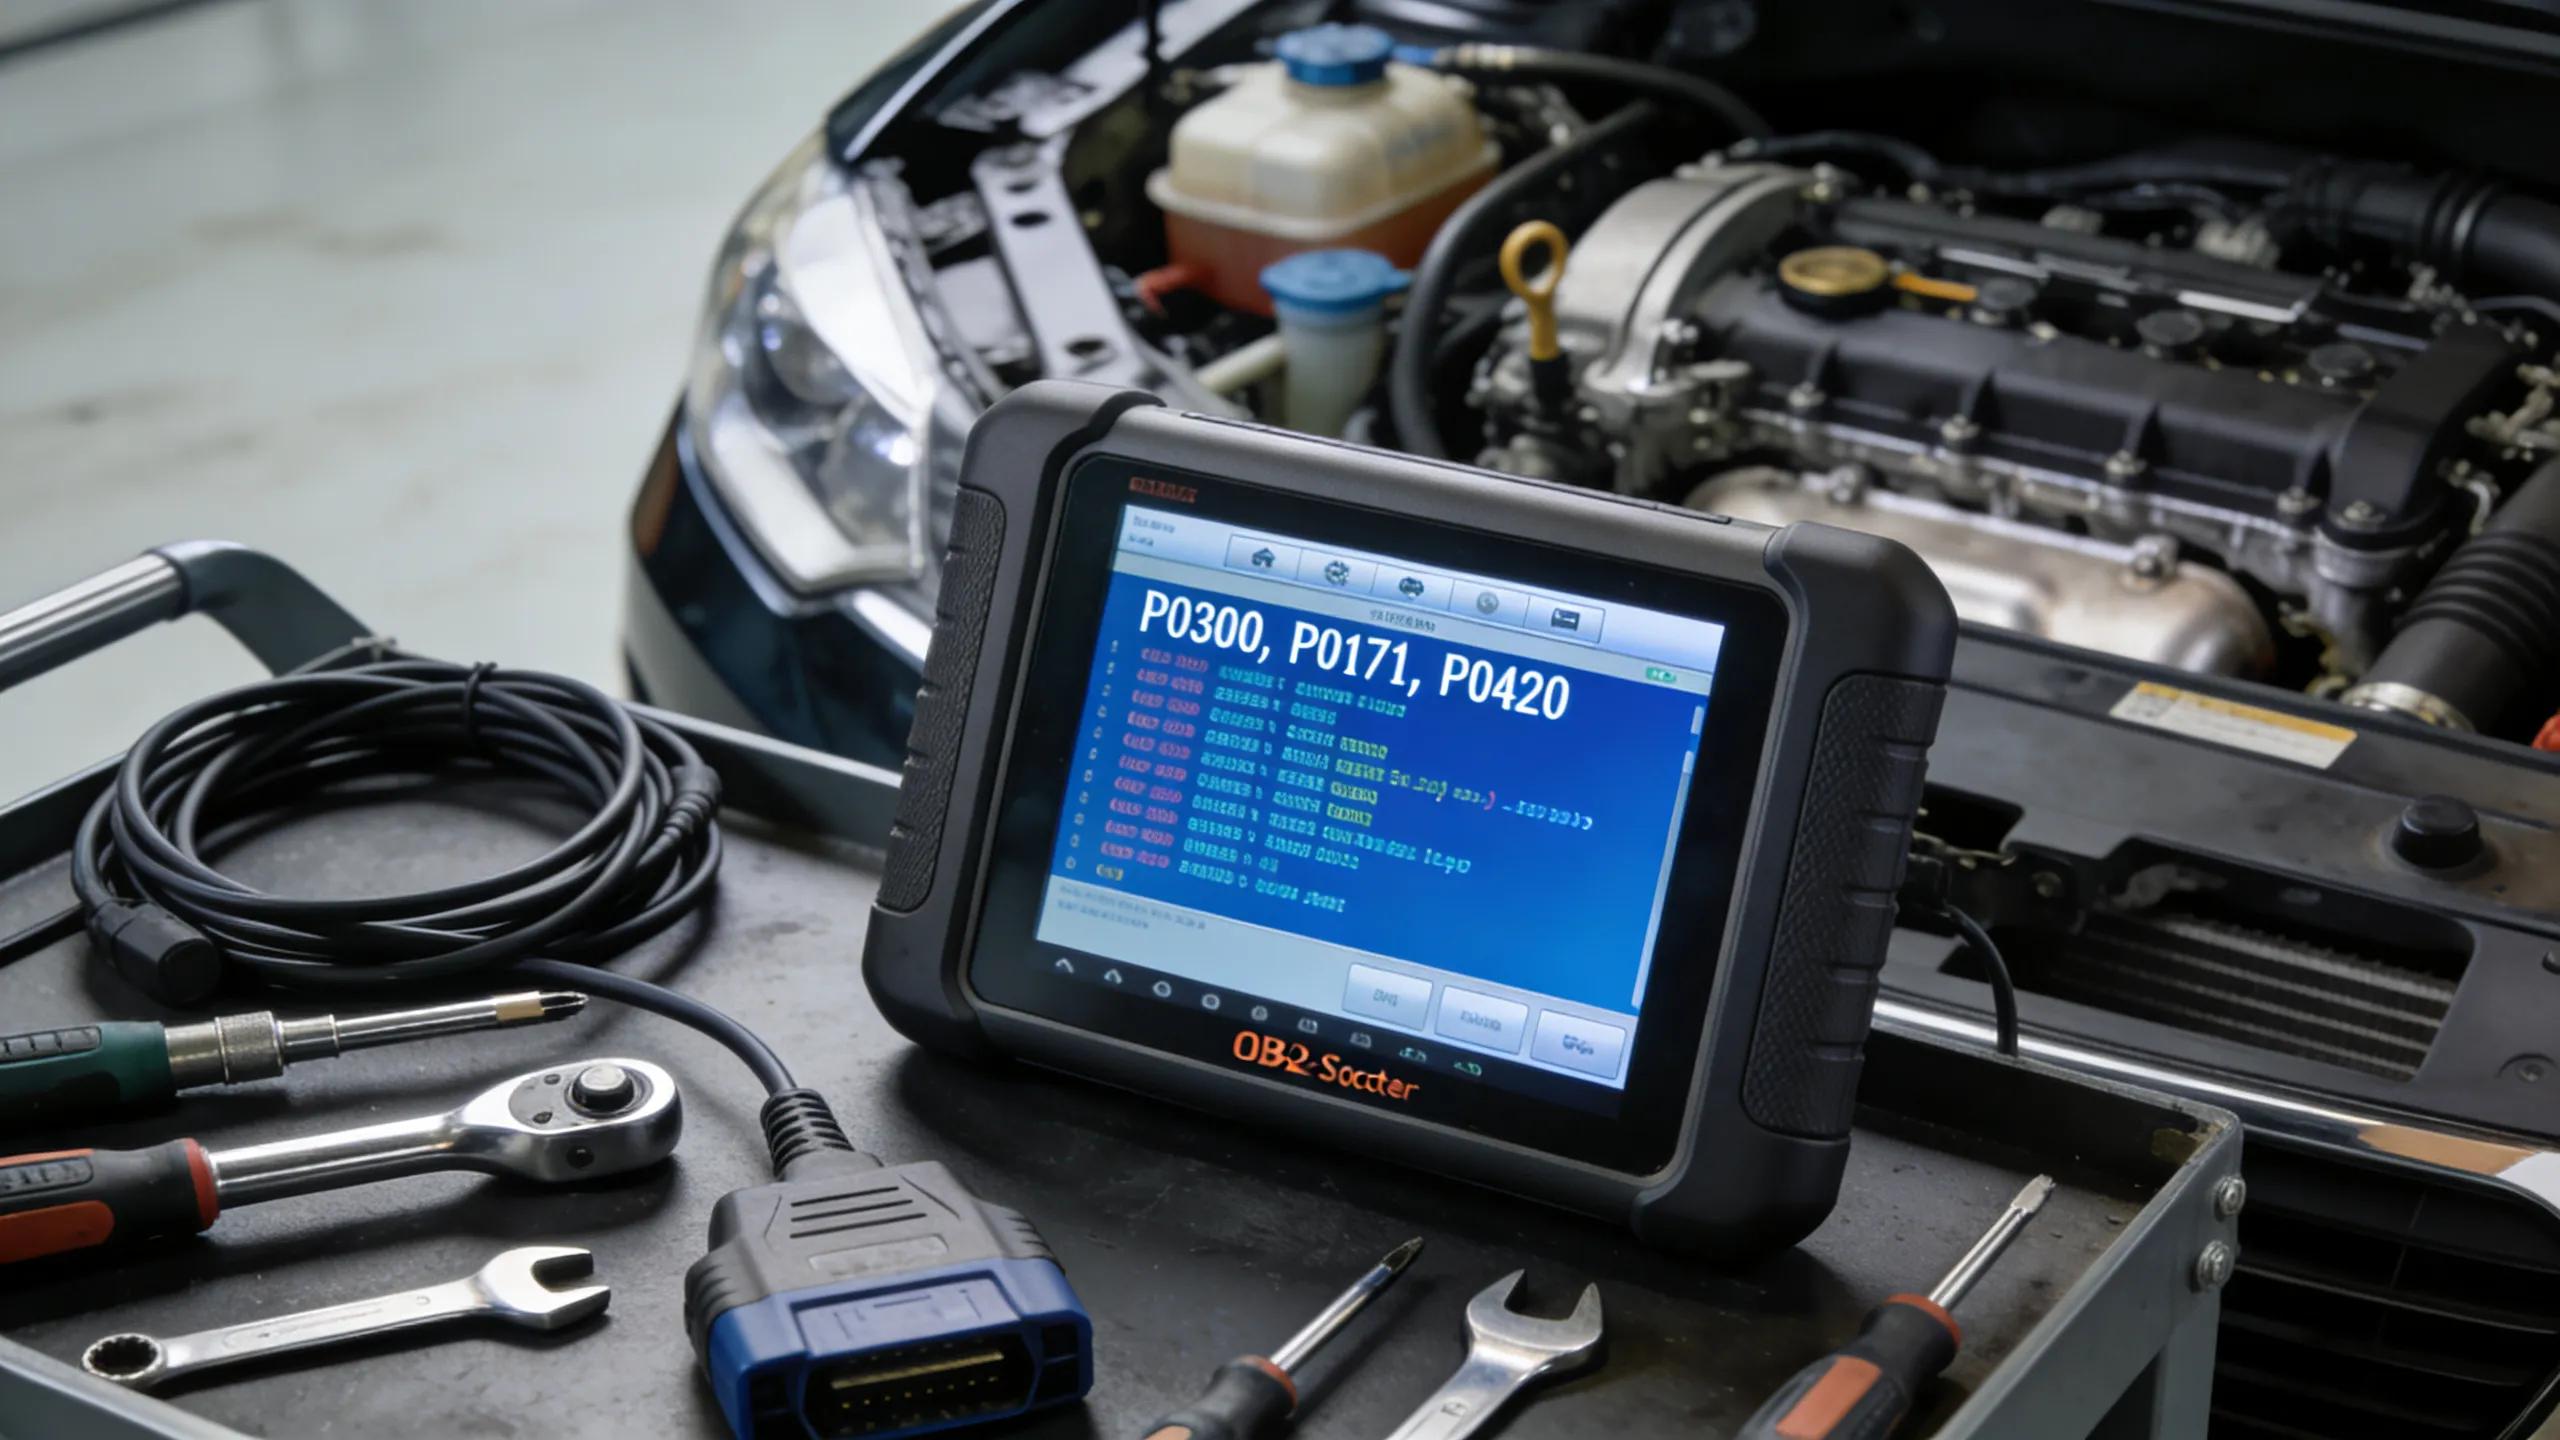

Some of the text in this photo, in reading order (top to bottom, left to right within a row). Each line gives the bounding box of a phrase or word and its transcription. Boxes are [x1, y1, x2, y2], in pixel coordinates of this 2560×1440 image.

[1139, 590, 1271, 664] P0300,
[1289, 621, 1421, 698] P0171,
[1439, 653, 1570, 720] P0420
